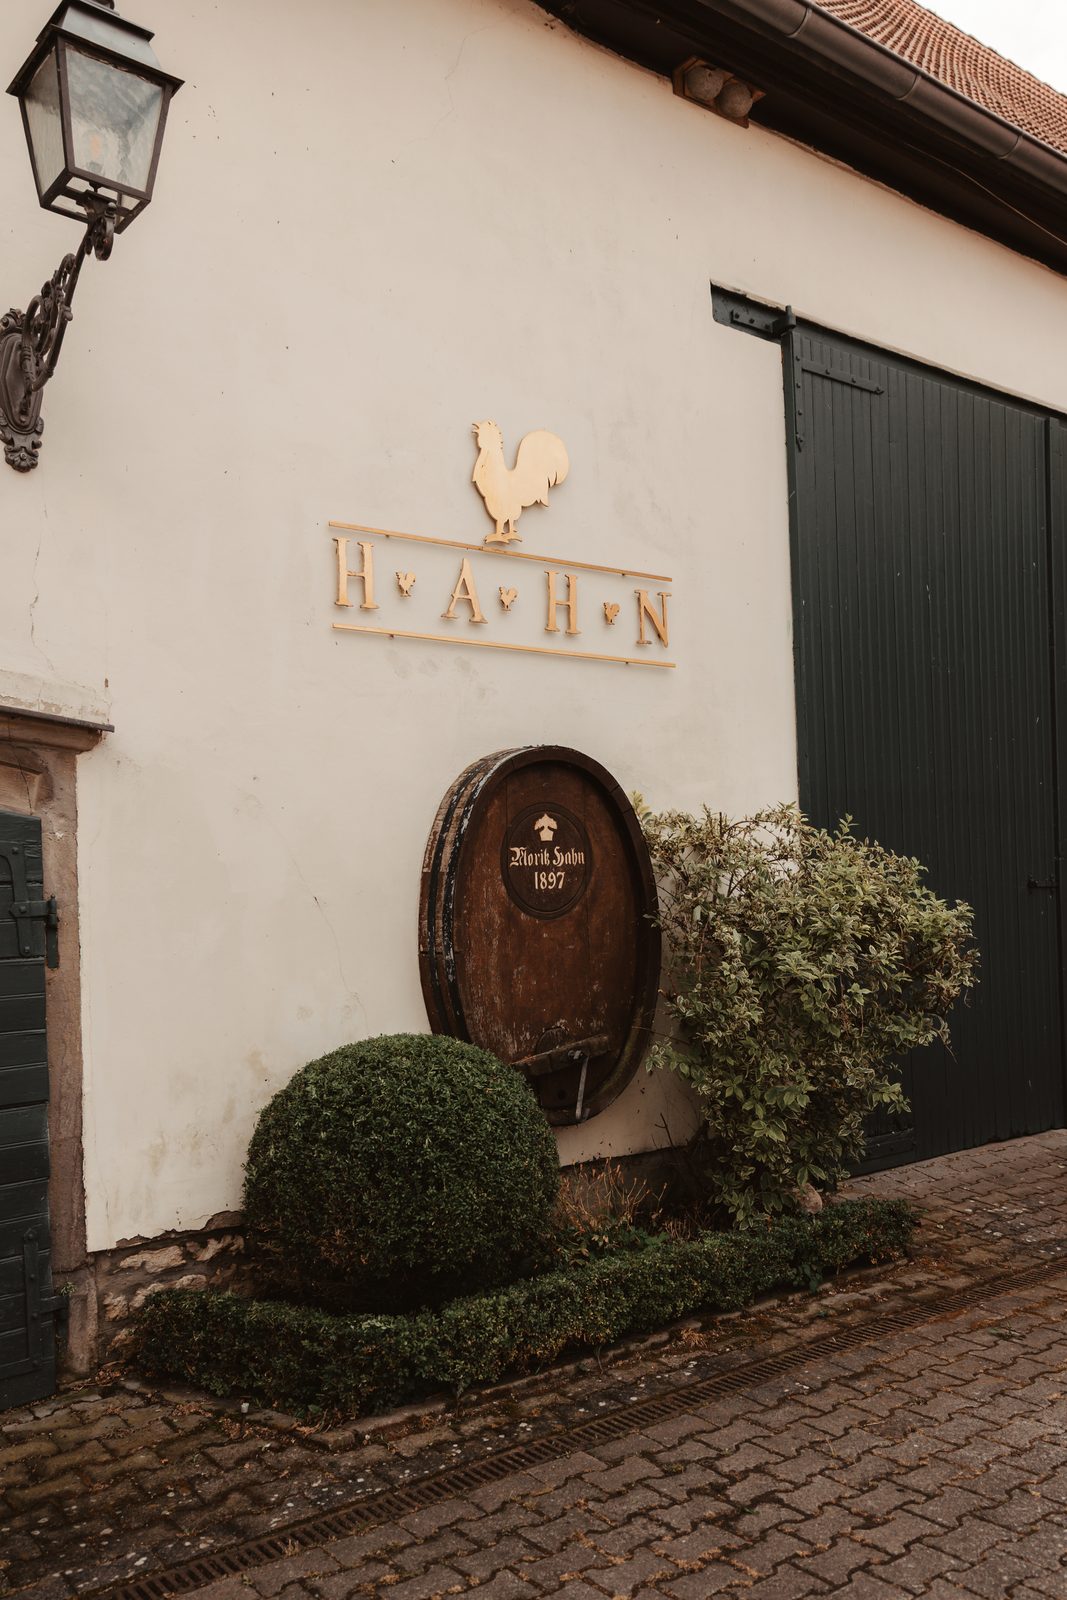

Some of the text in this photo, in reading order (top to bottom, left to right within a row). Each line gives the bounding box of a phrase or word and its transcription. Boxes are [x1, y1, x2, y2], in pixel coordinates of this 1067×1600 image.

[332, 537, 672, 648] HAHN
[552, 846, 585, 867] Hahn
[534, 871, 566, 890] 1897
